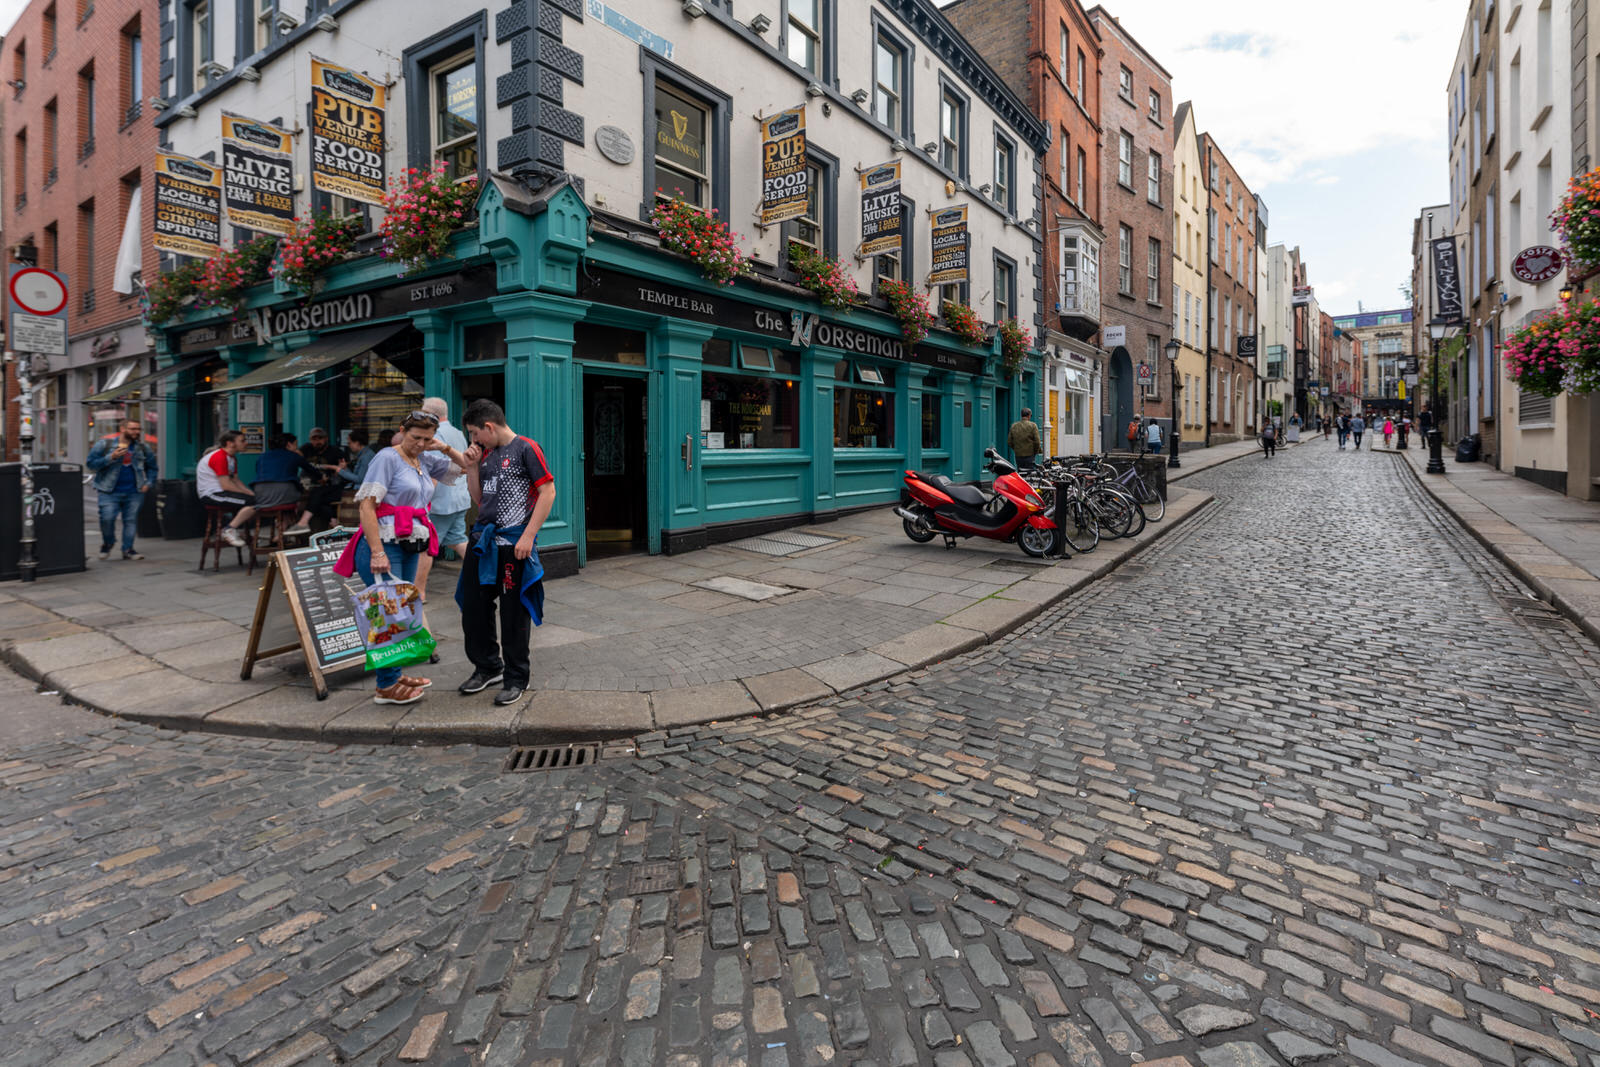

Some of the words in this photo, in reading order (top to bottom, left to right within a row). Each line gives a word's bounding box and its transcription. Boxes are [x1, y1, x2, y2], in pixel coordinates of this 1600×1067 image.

[314, 90, 382, 134] PUB
[314, 115, 368, 141] VENUE
[370, 134, 382, 146] &
[314, 126, 382, 153] RESTAURANT
[314, 136, 382, 168] FOOD
[658, 131, 700, 159] GUINNESS
[765, 134, 805, 163] PUB
[226, 152, 290, 183] LIVE
[315, 152, 382, 180] SERVED
[765, 156, 797, 172] VENUE
[799, 154, 805, 163] &
[765, 164, 806, 178] RESTAURANT
[226, 170, 290, 195] MUSIC
[765, 171, 806, 192] FOOD
[159, 186, 206, 205] LOCAL
[208, 199, 218, 208] &
[264, 194, 291, 205] DAYS
[764, 184, 806, 201] SERVED
[864, 192, 899, 212] LIVE
[158, 202, 218, 222] BOUTIQUE
[158, 211, 196, 227] GINS
[864, 205, 899, 222] MUSIC
[157, 220, 218, 241] SPIRITS!
[933, 234, 958, 244] LOCAL
[934, 254, 952, 264] GINS
[1521, 248, 1553, 259] COSTA
[933, 258, 965, 270] SPIRITS!
[1519, 267, 1558, 280] COFFEE
[411, 286, 429, 301] EST.
[432, 283, 452, 297] 1696
[638, 288, 689, 309] TEMPLE
[691, 299, 714, 315] BAR
[755, 310, 783, 331] The
[232, 323, 249, 339] The
[729, 402, 740, 414] THE
[741, 403, 772, 416] NORSEMAN
[314, 616, 354, 630] BREAKFAST
[336, 631, 359, 640] CARTE
[321, 641, 343, 650] SERVED
[371, 641, 416, 662] Reusable
